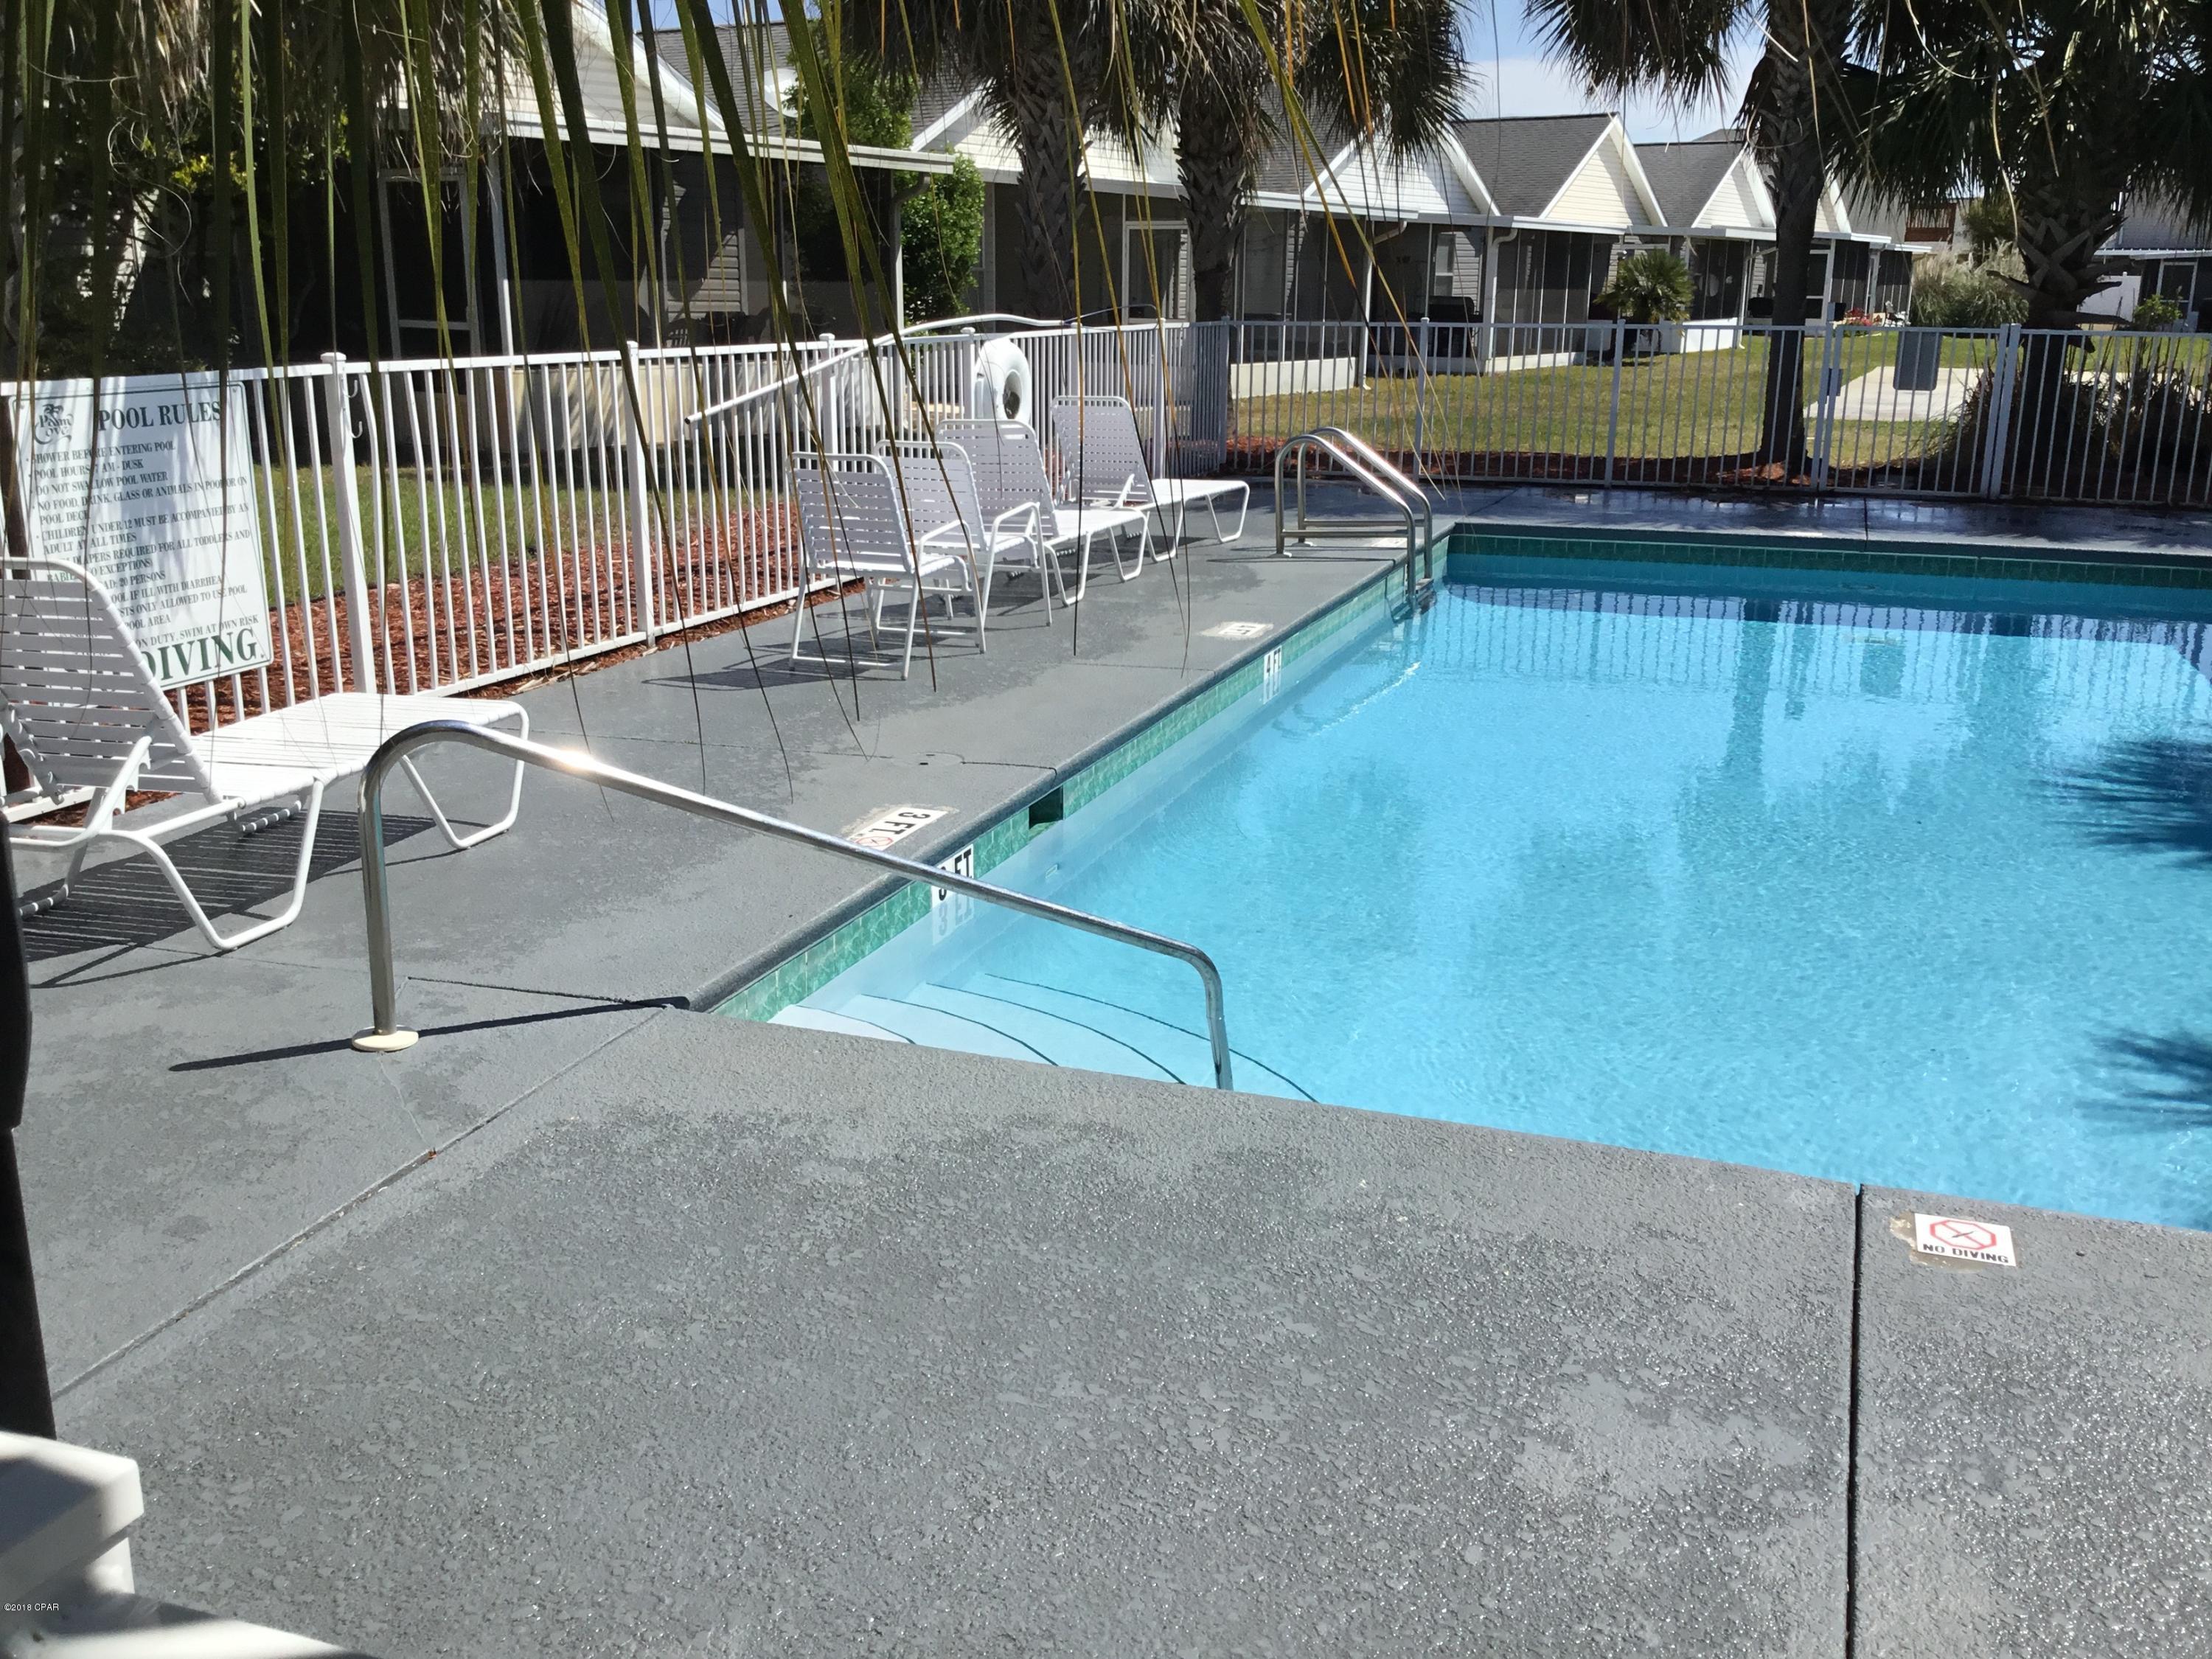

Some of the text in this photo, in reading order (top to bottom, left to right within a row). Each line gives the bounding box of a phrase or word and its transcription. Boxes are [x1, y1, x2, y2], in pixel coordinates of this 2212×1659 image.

[98, 401, 220, 431] POOL RULES
[109, 443, 153, 456] ENTERING
[155, 440, 175, 452] POOL
[35, 468, 58, 479] POOL
[122, 459, 143, 471] DUSK
[37, 486, 49, 496] DO
[52, 483, 69, 493] NOT
[116, 474, 139, 487] POOL
[139, 471, 168, 484] WATER
[38, 501, 50, 511] NO
[114, 489, 140, 502] GLASS
[142, 488, 153, 498] OR
[156, 483, 192, 497] ANIMALS
[40, 513, 64, 525] POOL
[91, 521, 122, 534] UNDER
[124, 519, 133, 529] 12
[133, 515, 156, 528] MUST
[159, 514, 169, 524] BE
[227, 504, 236, 515] BY
[44, 541, 73, 555] ADULT
[90, 535, 108, 548] ALL
[109, 532, 137, 545] TIMES
[73, 552, 111, 566] DIPERS
[114, 544, 156, 560] REQUIRED
[158, 542, 175, 553] FOR
[177, 539, 192, 550] ALL
[234, 529, 251, 540] AND
[111, 575, 223, 604] OOL IF ILL WITH DIARRHEA
[130, 570, 166, 585] PERSONS
[136, 602, 156, 613] ONLY
[159, 594, 199, 610] ALLOWED
[201, 592, 211, 602] TO
[228, 585, 248, 596] POOL
[147, 614, 171, 627] AREA
[180, 627, 203, 641] SWIM
[205, 624, 217, 635] AT
[240, 614, 259, 626] RISK
[1923, 1243, 2009, 1264] NO DIVING
